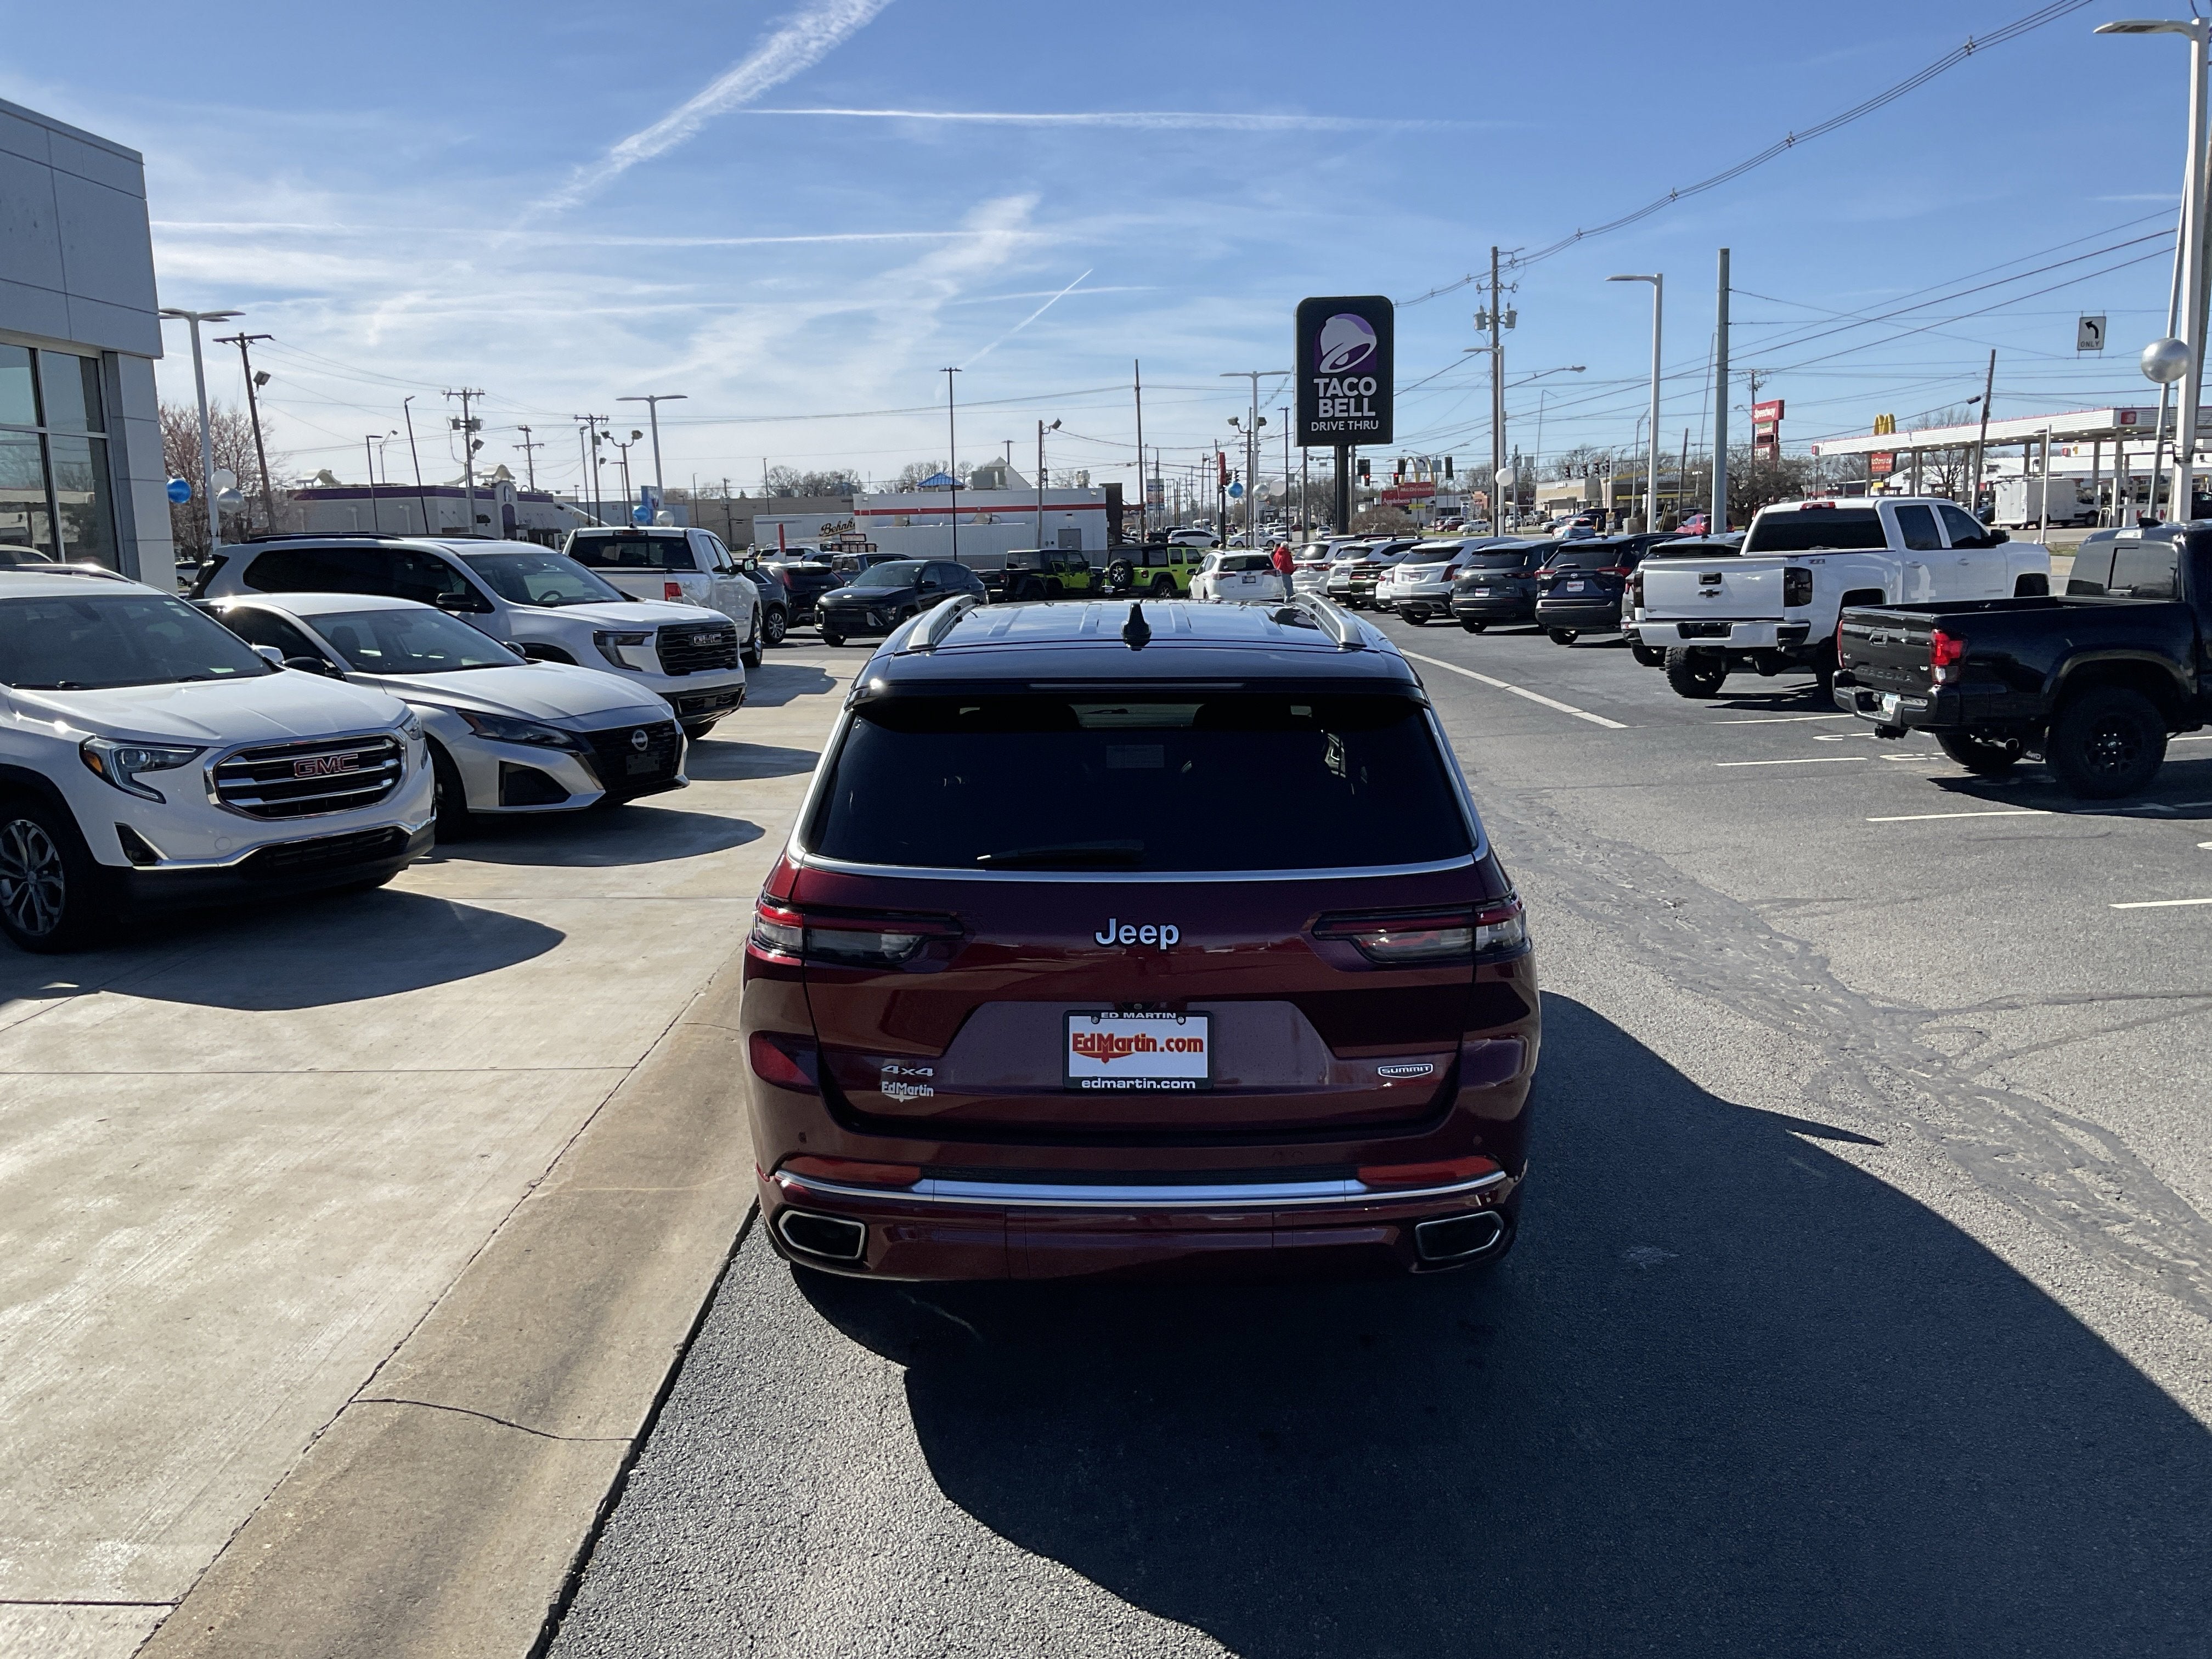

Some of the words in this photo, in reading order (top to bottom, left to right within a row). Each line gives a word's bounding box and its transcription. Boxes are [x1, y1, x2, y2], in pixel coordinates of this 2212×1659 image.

[1313, 377, 1377, 397] TACO
[1318, 398, 1376, 418] BELL
[1754, 407, 1776, 421] Speedway
[1311, 421, 1345, 431] DRIVE
[1349, 420, 1379, 430] THRU
[819, 517, 855, 537] Behnk
[693, 633, 721, 645] GMC
[1860, 668, 1913, 682] TACOMA
[294, 753, 359, 777] GMC
[1096, 918, 1179, 950] Jeep
[881, 1065, 934, 1076] 4x4
[1081, 1078, 1196, 1088] edmartin.com
